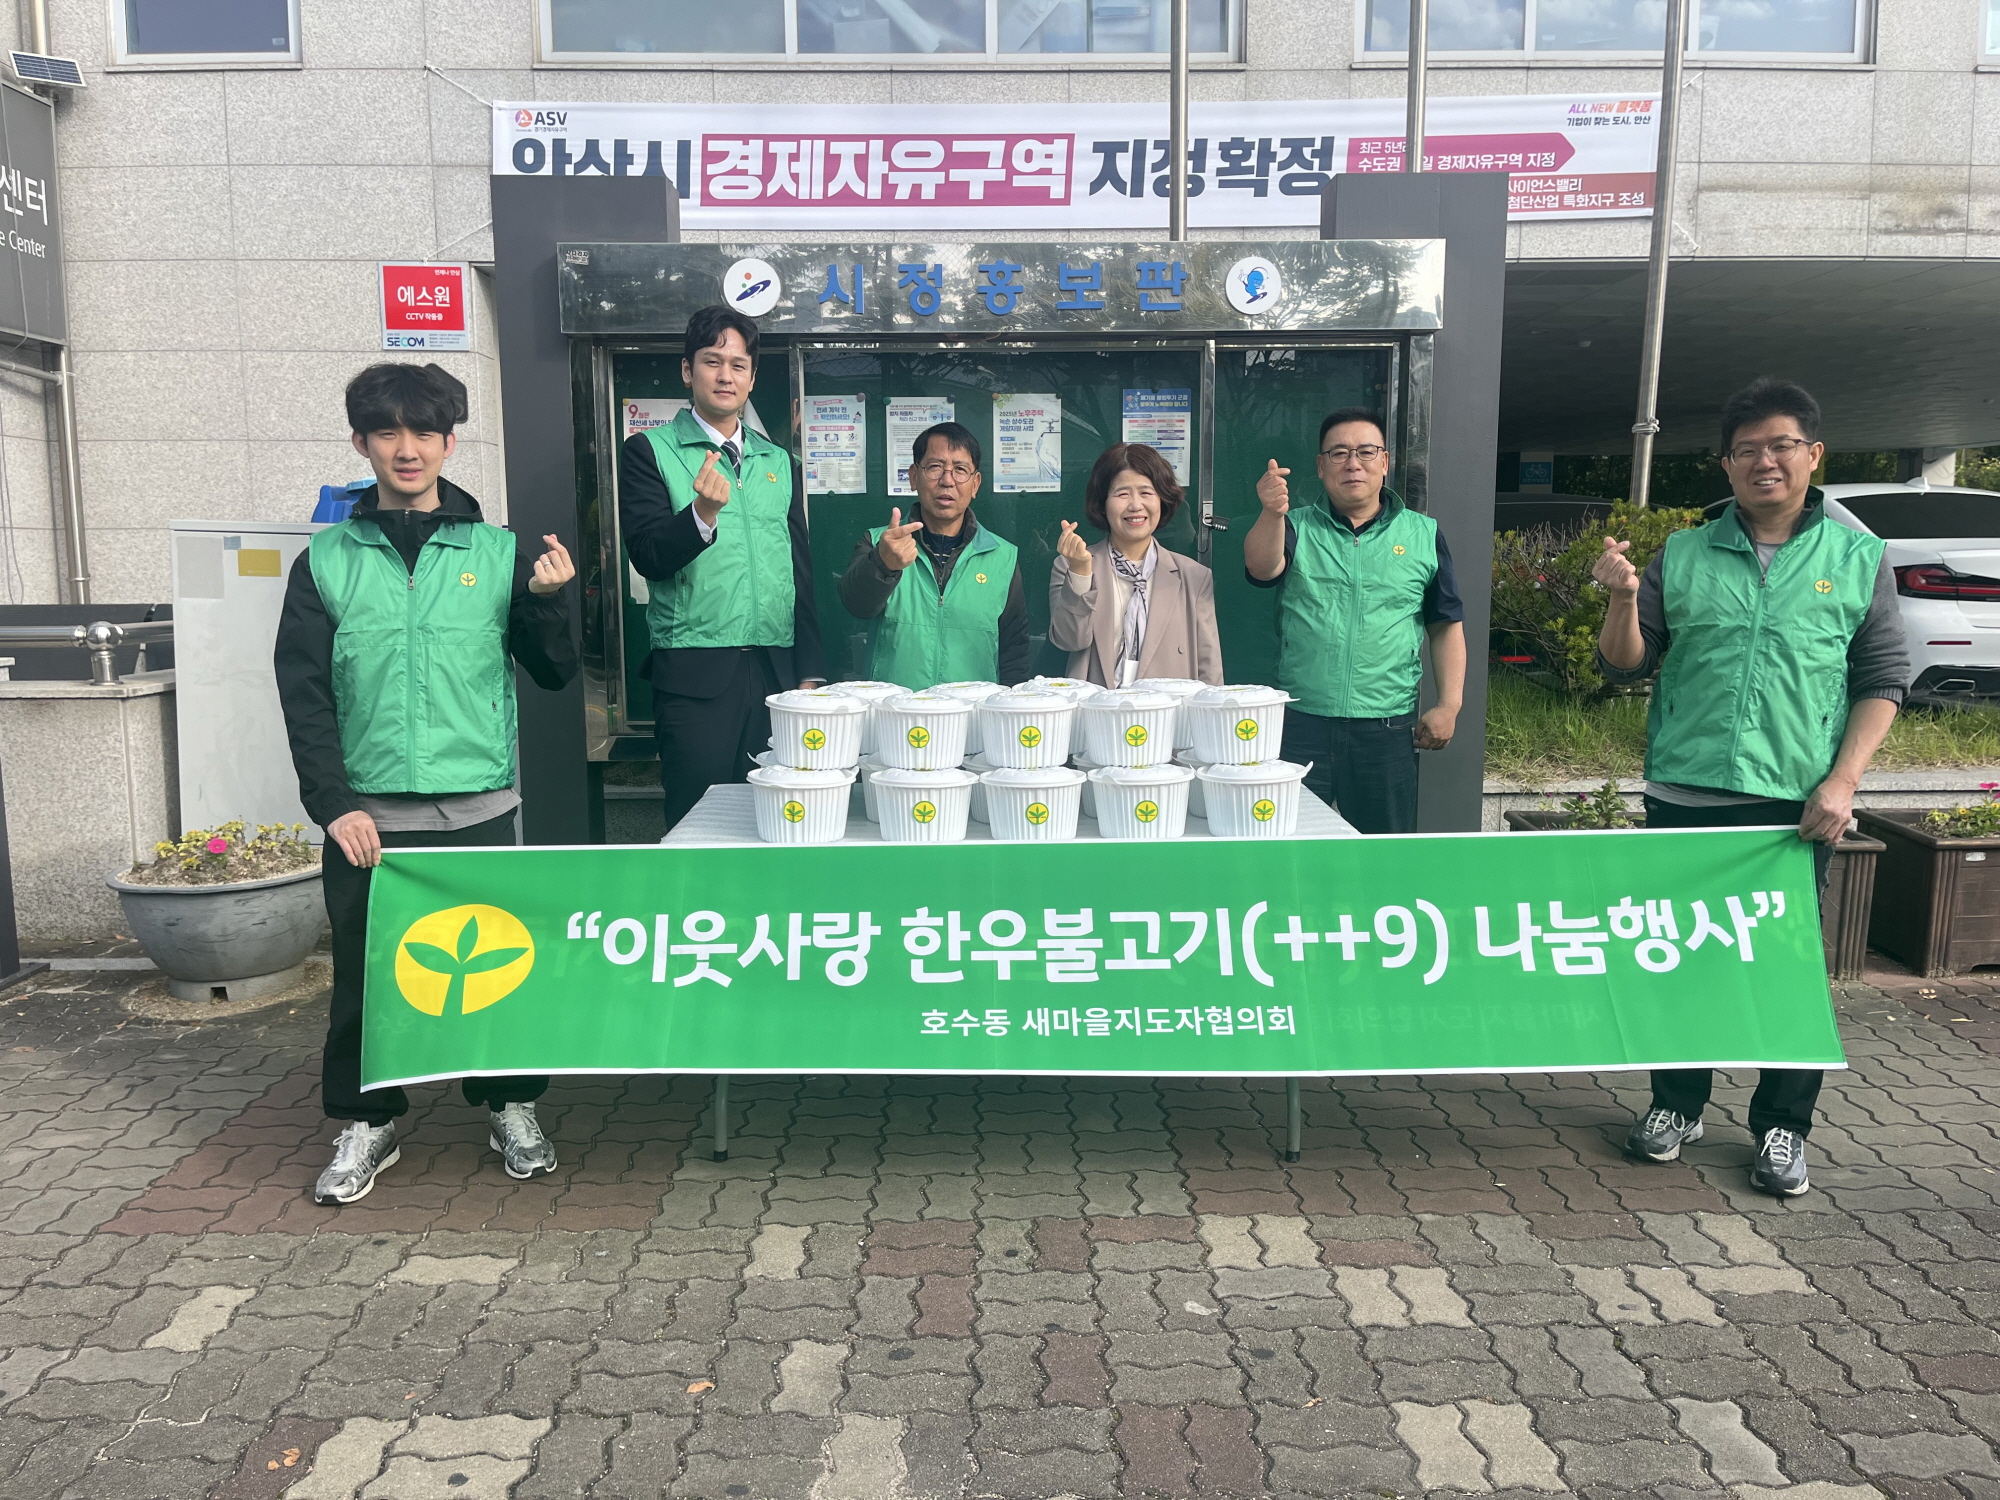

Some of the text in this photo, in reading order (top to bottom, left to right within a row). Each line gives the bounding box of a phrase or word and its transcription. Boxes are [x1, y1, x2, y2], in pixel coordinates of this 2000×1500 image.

[1568, 103, 1588, 114] ALL
[1589, 102, 1616, 114] NEW
[534, 111, 568, 126] ASV
[1566, 117, 1592, 127] 기업이
[1593, 116, 1610, 126] 찾는
[1633, 115, 1651, 125] 안산
[1358, 141, 1382, 154] 최근
[706, 138, 1068, 201] 경제자유구역
[1357, 156, 1401, 172] 수도권
[1437, 154, 1523, 170] 경제자유구역
[1525, 152, 1556, 168] 지정
[1508, 191, 1645, 210] 첨단산업 특화지구 조성
[9, 230, 46, 259] Center
[397, 285, 451, 307] 에스원
[818, 260, 1188, 316] 시정홍보판
[405, 312, 444, 321] CCTV 작동중
[387, 337, 425, 347] SECOM
[567, 889, 1787, 989] “이웃사랑 한우불고기(++9) 나눔행사”
[919, 1008, 1011, 1038] 호수동
[1021, 1005, 1297, 1038] 새마을지도자협의회
